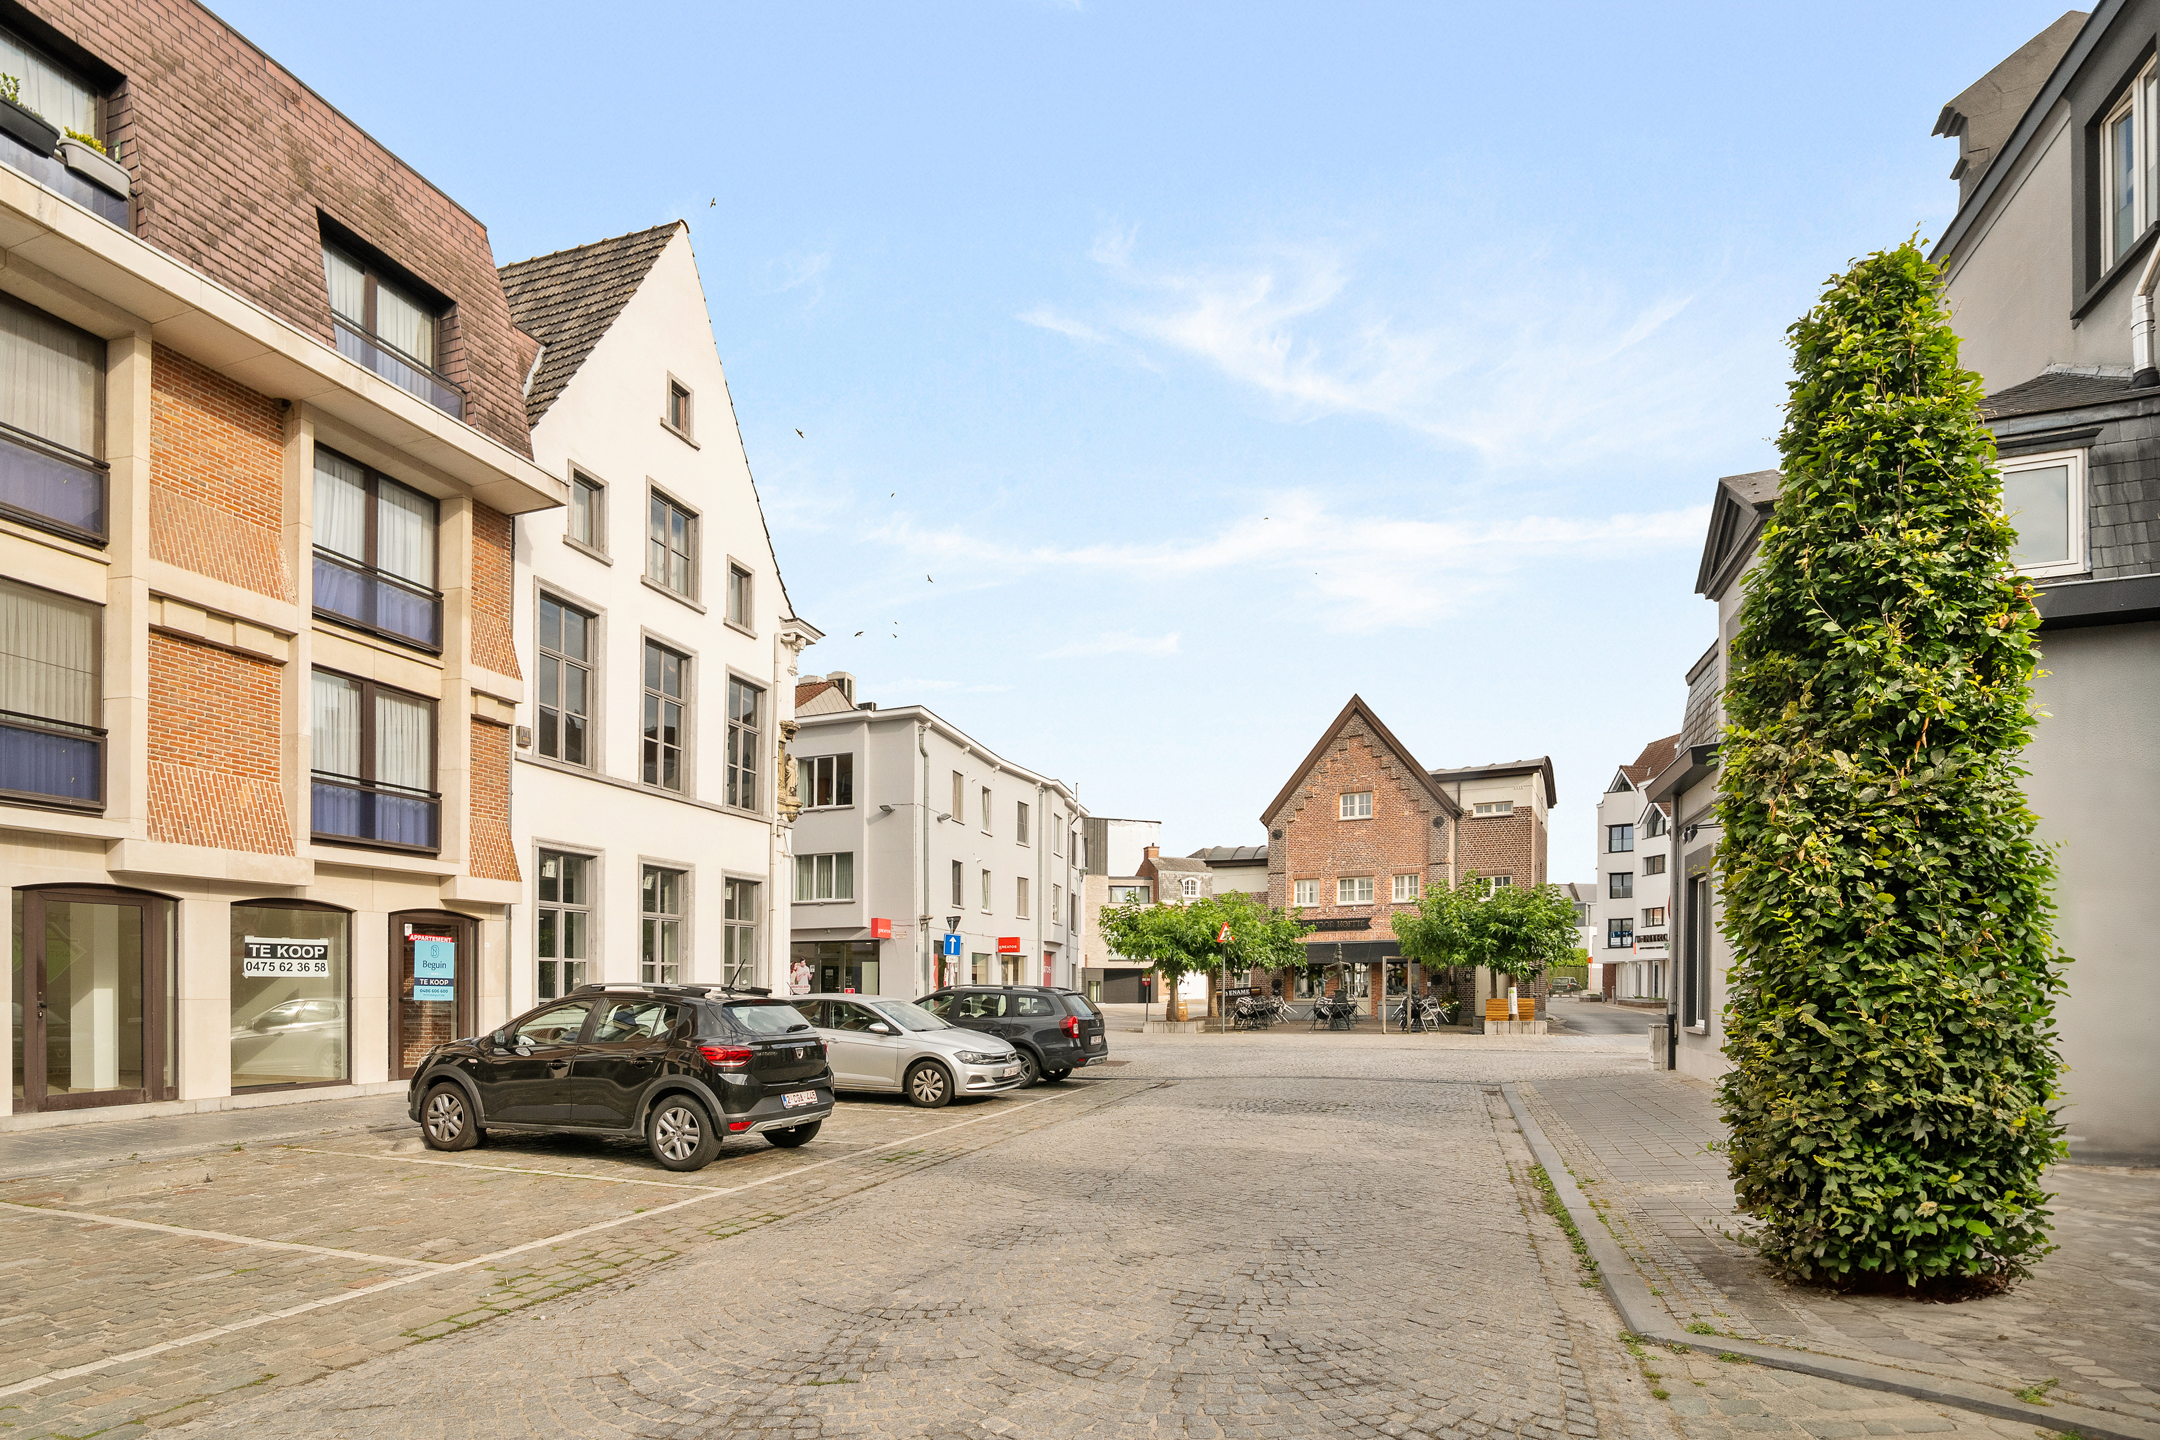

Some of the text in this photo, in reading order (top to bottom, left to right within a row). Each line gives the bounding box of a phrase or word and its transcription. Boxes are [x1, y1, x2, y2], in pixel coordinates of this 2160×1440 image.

[1337, 920, 1365, 928] KOFFIE
[410, 934, 452, 943] APPARTEMENT
[249, 944, 325, 958] TE KOOP
[245, 961, 326, 972] 0475 62 36 58
[422, 960, 447, 971] Beguin
[1228, 988, 1251, 997] ENAME
